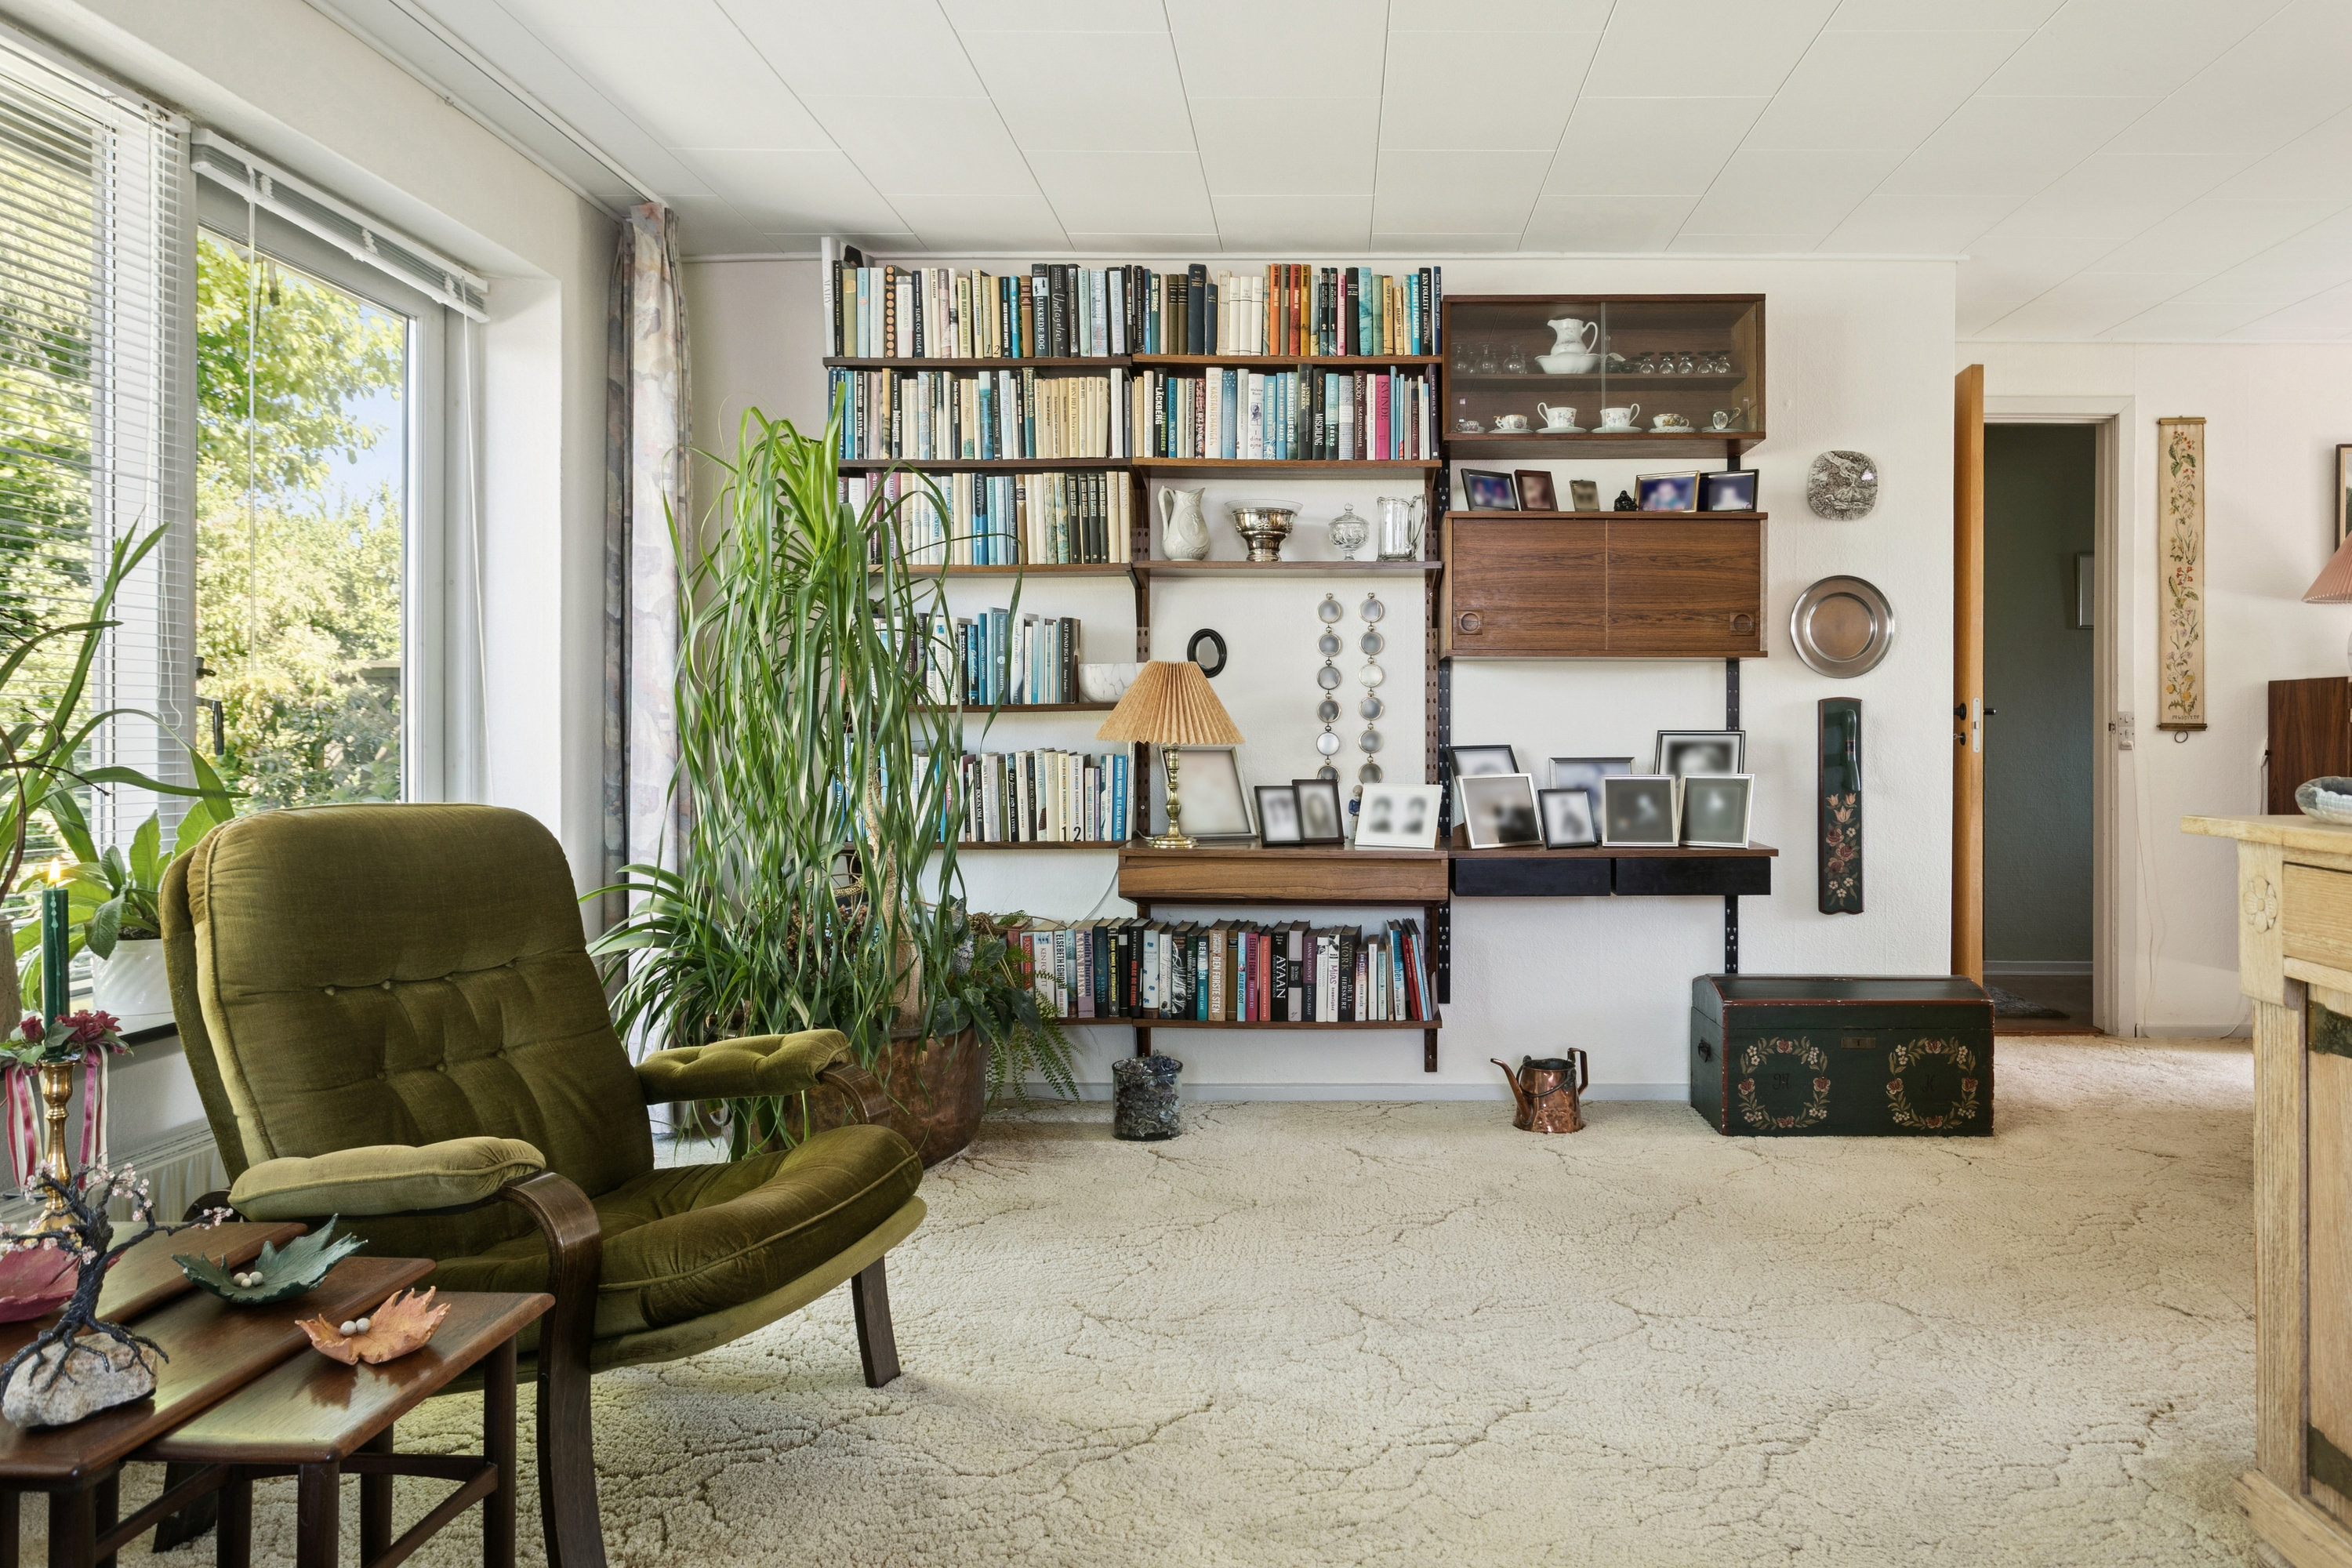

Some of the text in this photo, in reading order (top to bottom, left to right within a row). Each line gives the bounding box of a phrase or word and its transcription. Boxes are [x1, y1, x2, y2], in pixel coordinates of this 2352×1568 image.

[1052, 293, 1065, 342] Undtagelsen
[1156, 387, 1164, 424] LÄCKBERG
[1314, 413, 1323, 445] MISCHLING
[1056, 935, 1065, 963] ELSEBETH
[1212, 956, 1221, 969] DEN
[1212, 971, 1221, 995] FØRSTE
[1276, 955, 1286, 999] AYAAN
[1330, 965, 1338, 984] Mias
[1212, 996, 1221, 1013] STEN
